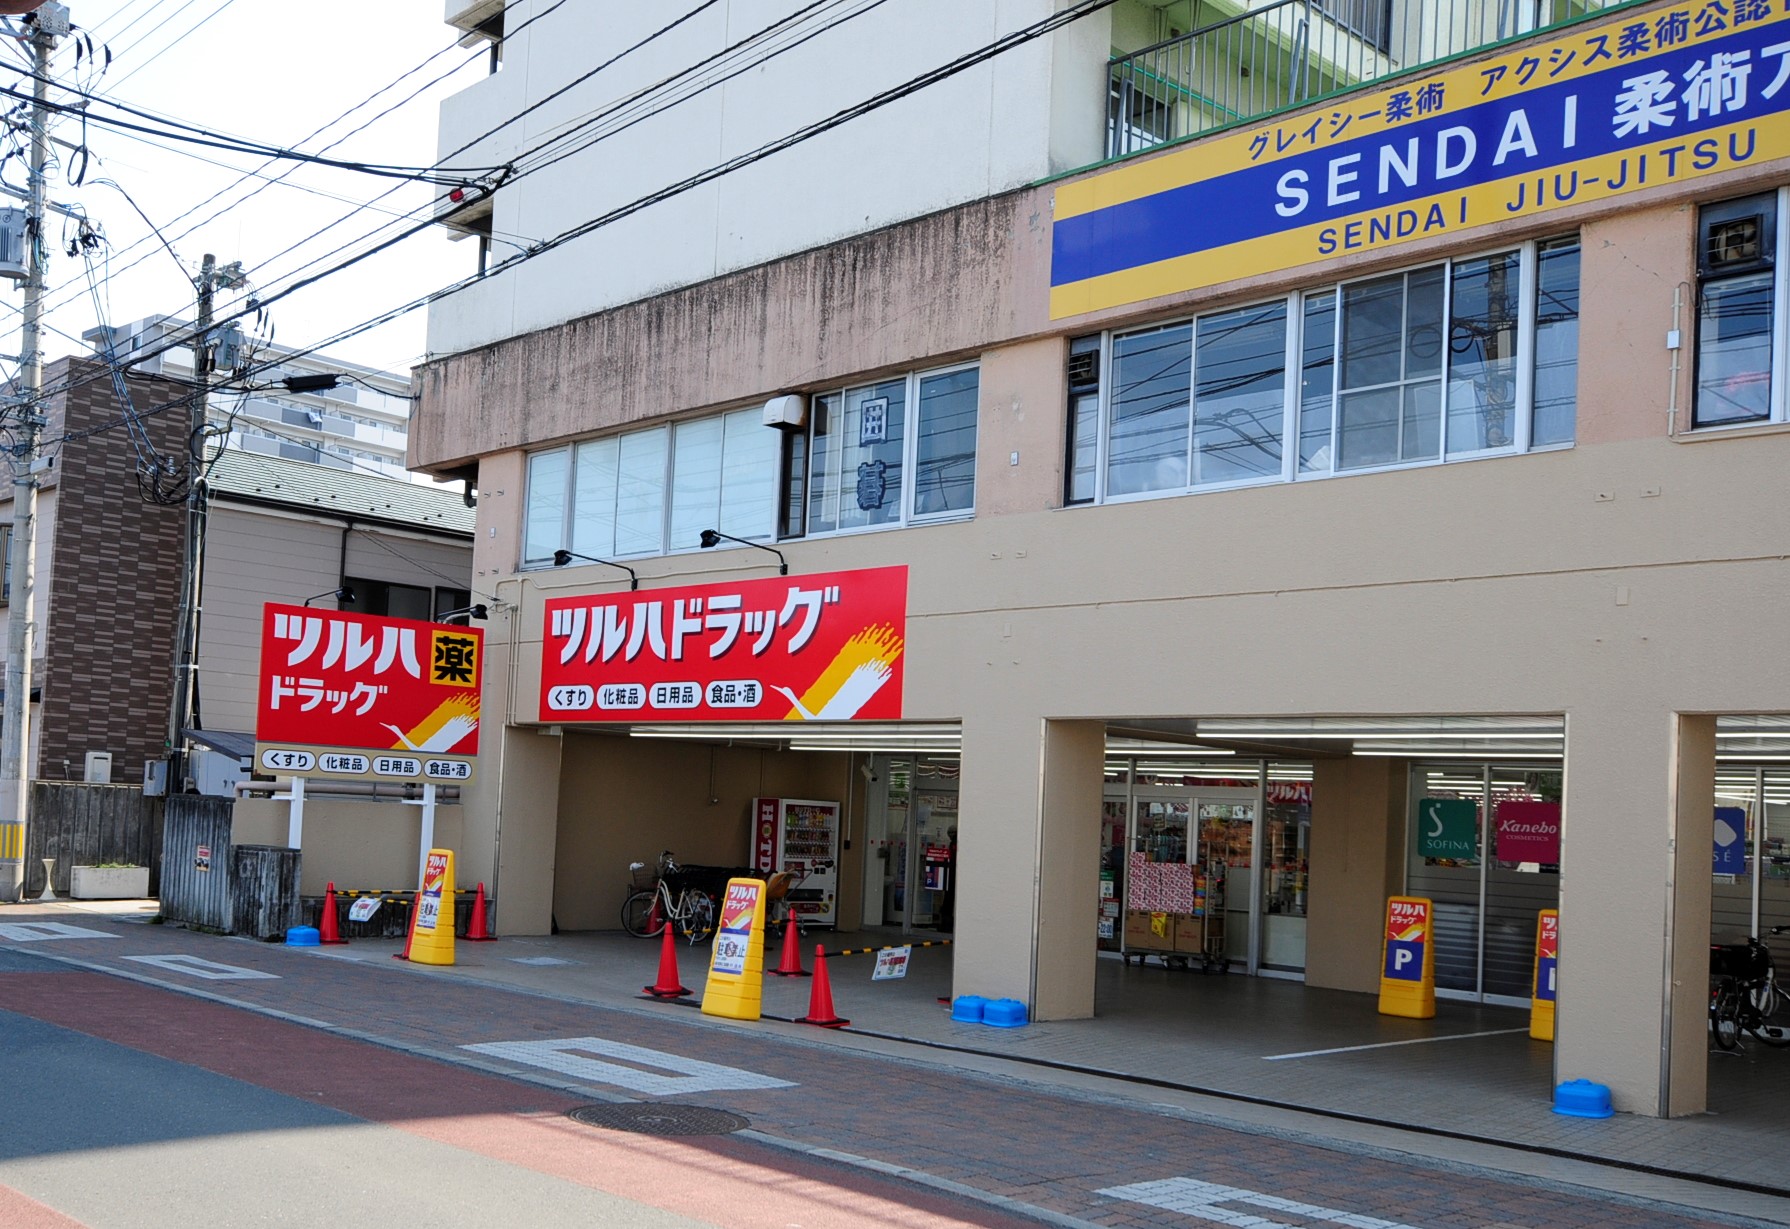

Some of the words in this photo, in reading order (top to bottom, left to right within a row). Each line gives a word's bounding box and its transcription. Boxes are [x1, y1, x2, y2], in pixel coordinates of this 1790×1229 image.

[1248, 82, 1445, 161] グレイシー柔術
[1480, 0, 1790, 96] アクシス柔術公認
[1274, 95, 1578, 217] SENDAI
[1318, 196, 1467, 254] SENDAI
[1506, 128, 1756, 212] JIU-JITSU
[551, 586, 840, 665] ツルハドラッグ
[273, 612, 421, 680] ツルハ
[434, 635, 475, 683] 薬
[270, 675, 389, 716] ドラッグ
[554, 688, 588, 706] くすり
[603, 687, 639, 705] 化粧品
[656, 686, 694, 704] 日用品
[270, 752, 308, 766] くすり
[326, 756, 363, 771] 化粧品
[379, 759, 414, 774] 日用品
[1267, 785, 1312, 801] ツルハ
[1500, 820, 1557, 834] Kanebo
[1426, 840, 1470, 850] SOFINA
[1505, 834, 1550, 842] COSMETICS
[729, 886, 757, 900] ツルハ
[726, 900, 750, 910] ドラッグ
[1391, 902, 1425, 916] ツルハ
[1390, 916, 1417, 925] ドラッグ
[1543, 917, 1557, 930] ツ
[1394, 949, 1413, 971] P
